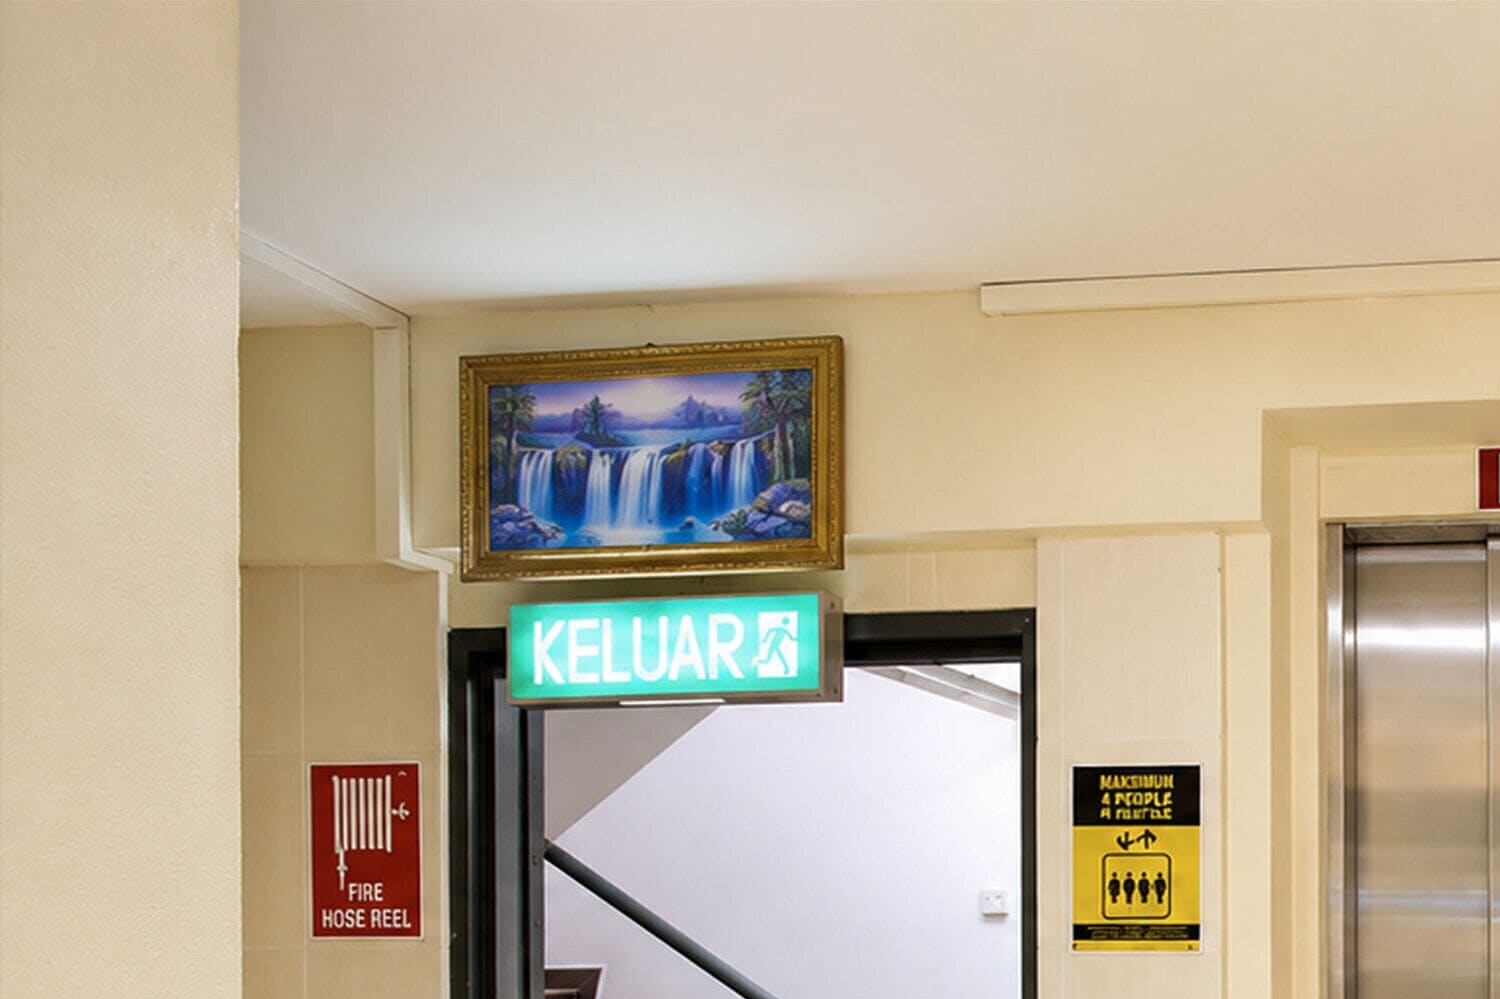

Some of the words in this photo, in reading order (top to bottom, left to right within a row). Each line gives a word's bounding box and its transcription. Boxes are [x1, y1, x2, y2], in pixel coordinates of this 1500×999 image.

[533, 613, 745, 685] KELUAR
[348, 882, 384, 902] FIRE
[322, 908, 366, 929] HOSE
[370, 908, 412, 929] REEL
